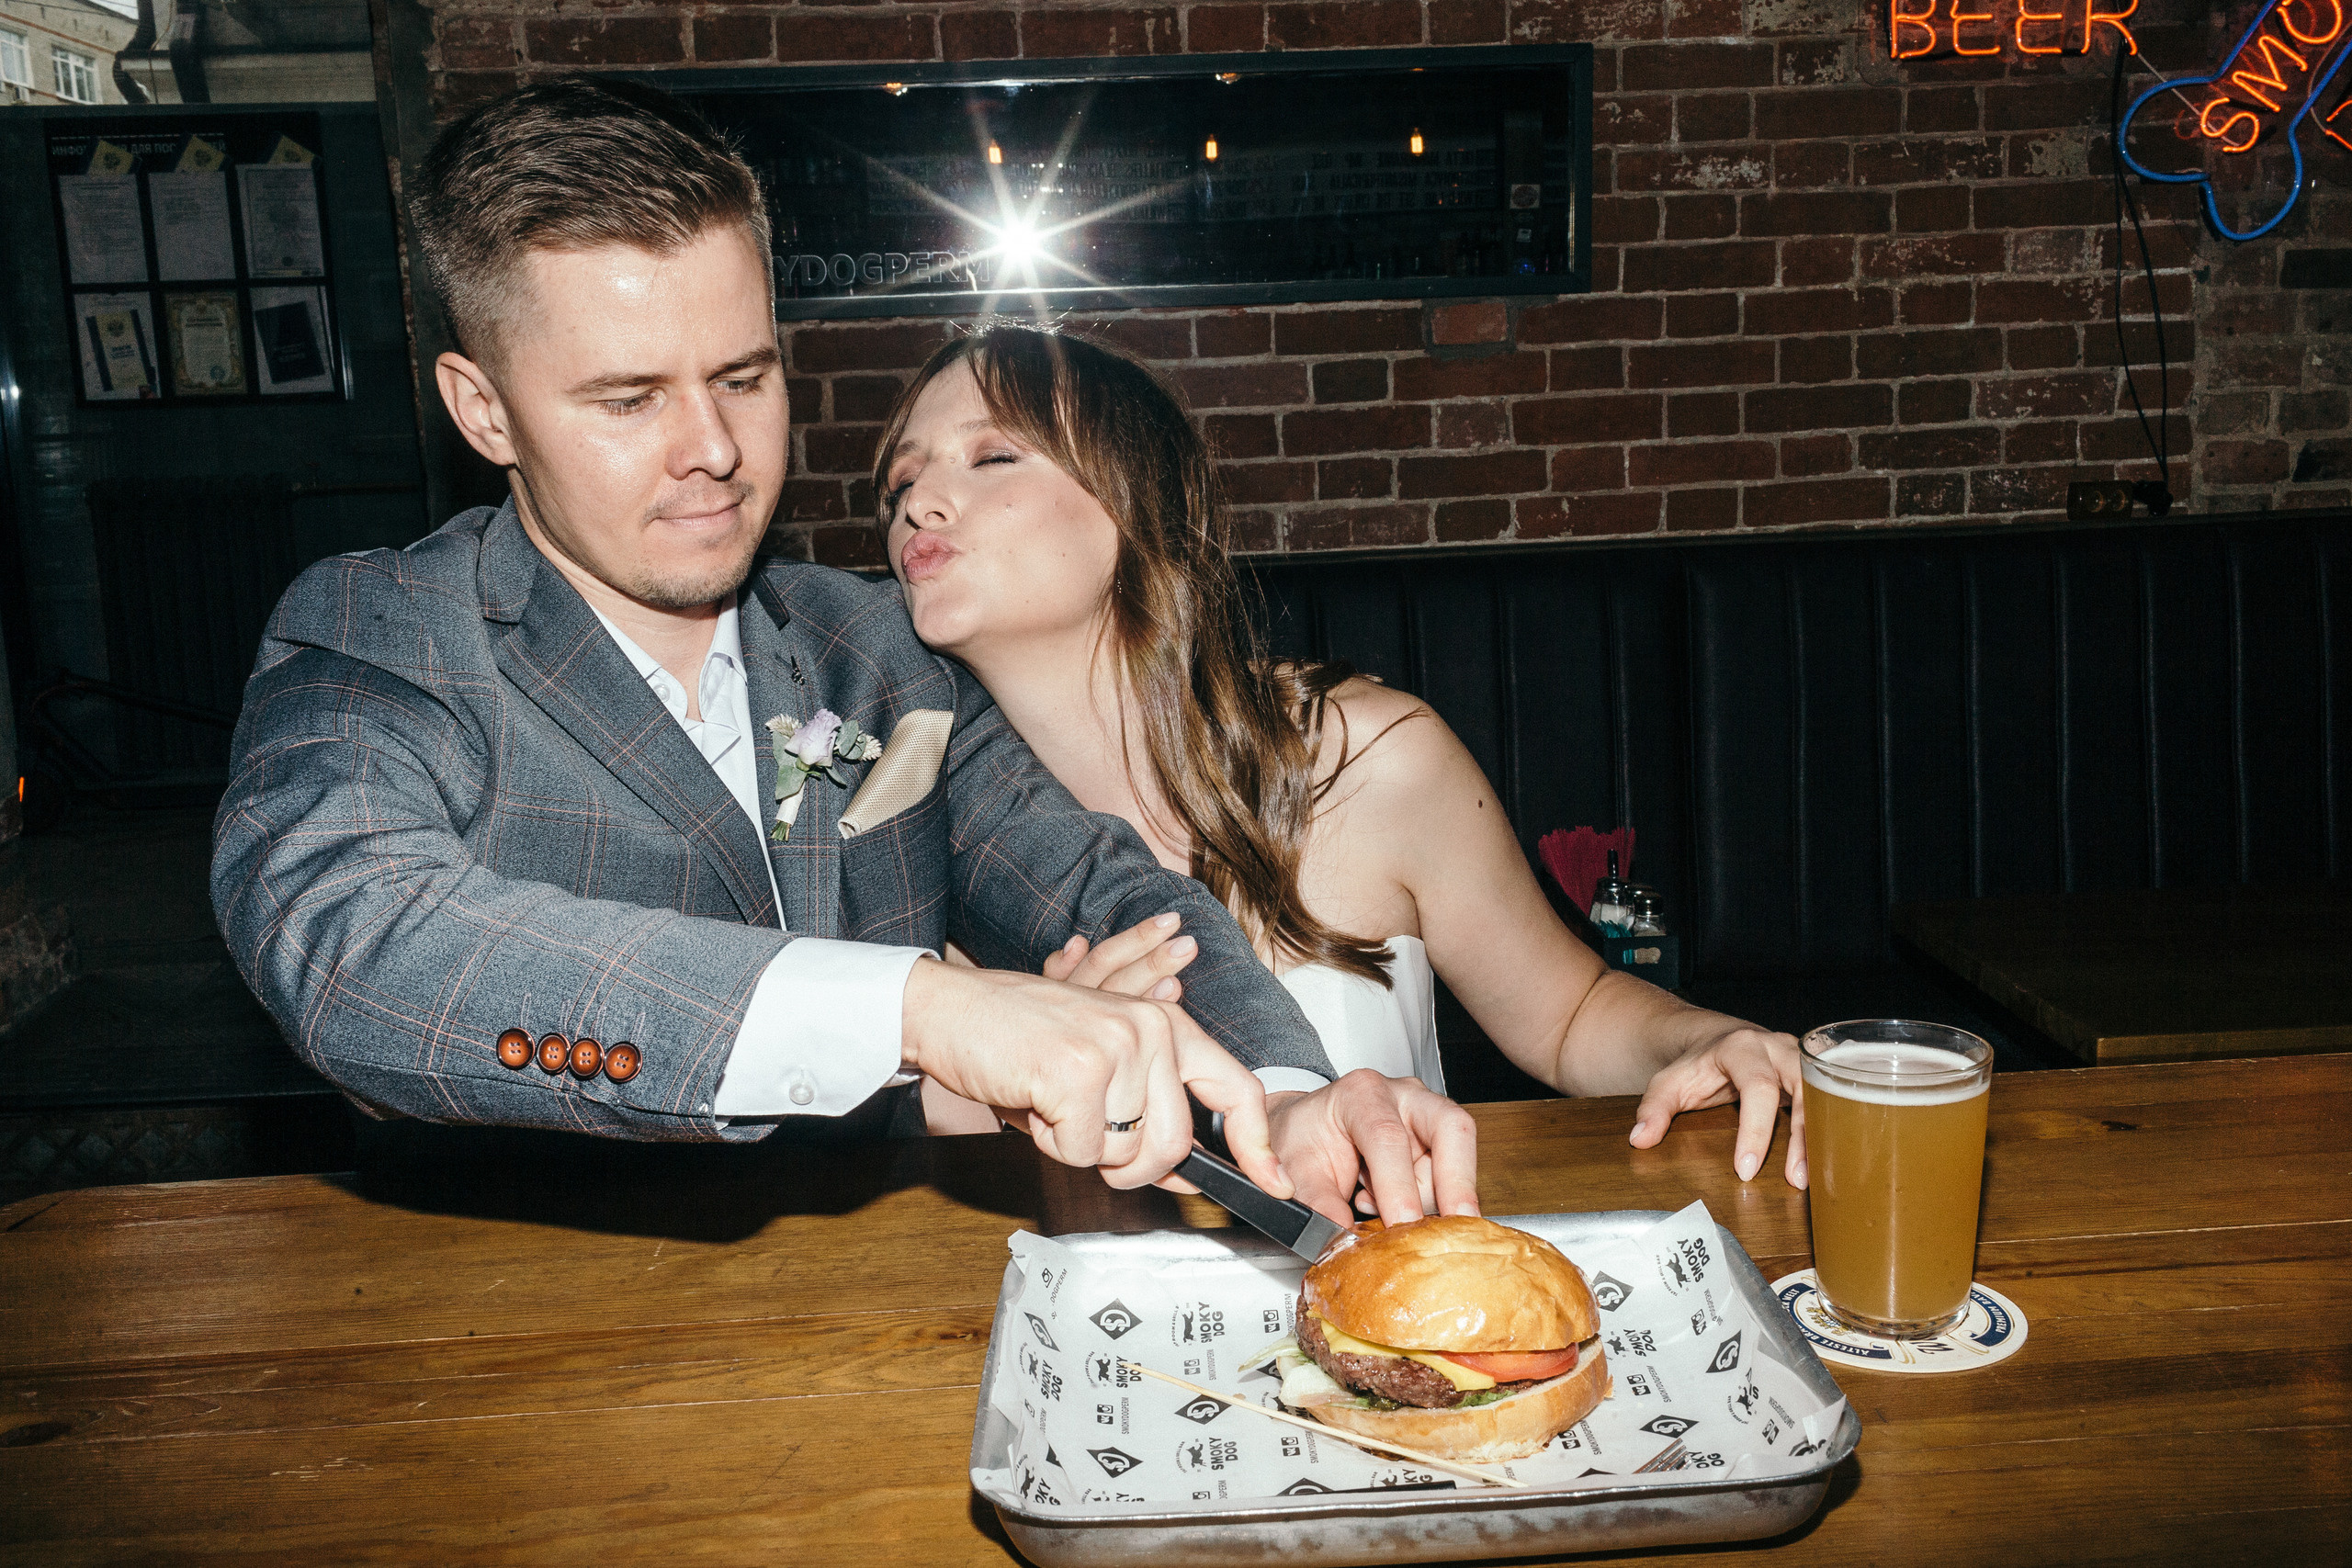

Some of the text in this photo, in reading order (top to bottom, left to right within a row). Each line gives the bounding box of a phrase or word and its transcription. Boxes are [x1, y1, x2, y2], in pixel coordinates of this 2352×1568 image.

[1889, 0, 2138, 59] BEER
[1677, 1239, 1704, 1282] SMOKY
[1693, 1237, 1711, 1267] DOG
[1198, 1302, 1213, 1343] SMOKY
[1212, 1311, 1225, 1337] DOG
[1987, 1305, 2007, 1334] PREMIUM
[1041, 1359, 1053, 1400] SMOKY
[1115, 1356, 1128, 1388] SMOKY
[1051, 1375, 1063, 1402] DOG
[1209, 1437, 1225, 1470] SMOKY
[1224, 1441, 1238, 1461] DOG
[1689, 1451, 1710, 1469] OKY
[1707, 1452, 1724, 1467] OG
[1034, 1478, 1051, 1504] OKY
